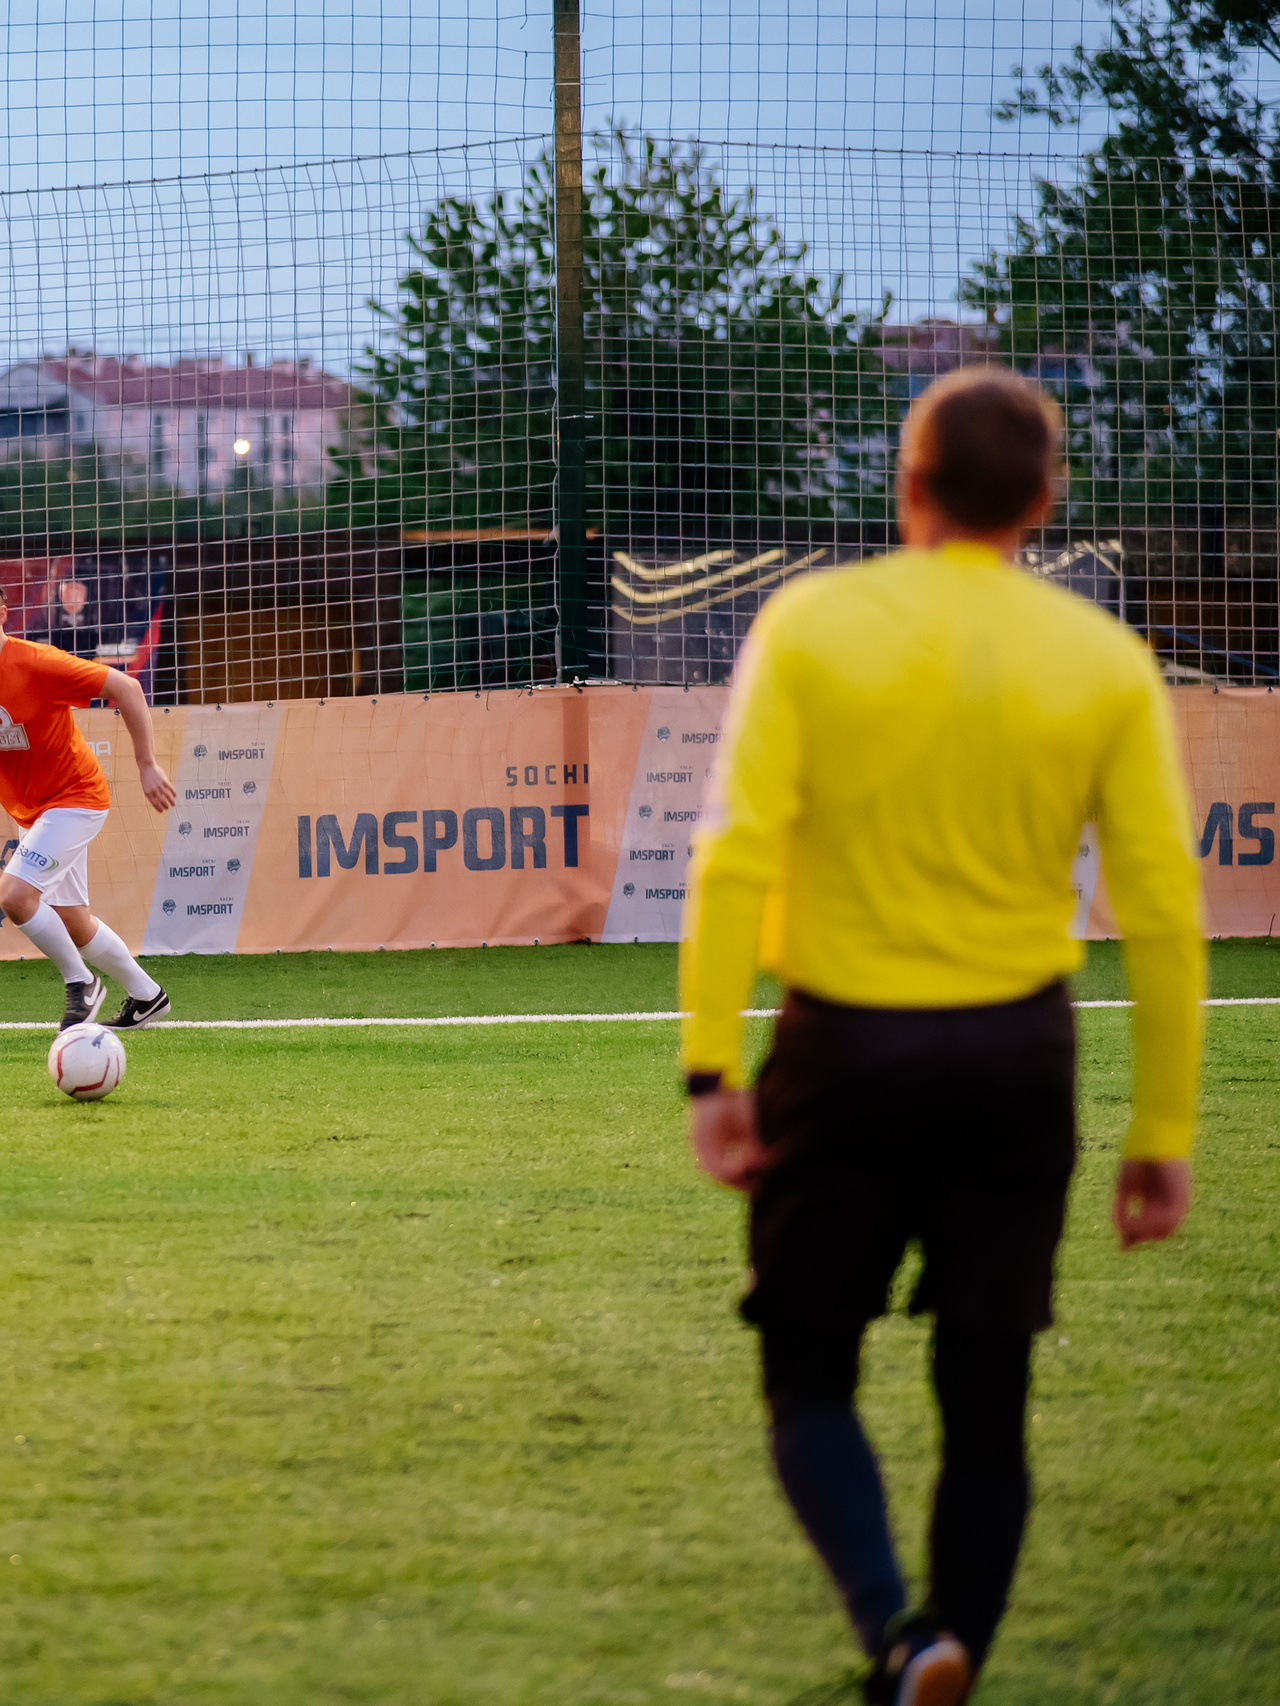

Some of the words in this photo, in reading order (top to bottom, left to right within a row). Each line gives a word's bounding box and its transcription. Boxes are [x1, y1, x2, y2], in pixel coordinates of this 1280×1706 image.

[218, 749, 265, 761] IMSPORT
[506, 764, 589, 786] SOCHI
[646, 772, 693, 783] IMSPORT
[185, 788, 231, 800] IMSPORT
[663, 811, 703, 822] IMSPO
[203, 826, 250, 838] IMSPORT
[297, 804, 590, 878] IMSPORT
[629, 850, 675, 861] IMSPORT
[169, 866, 215, 878] IMSPORT
[187, 903, 233, 916] IMSPORT
